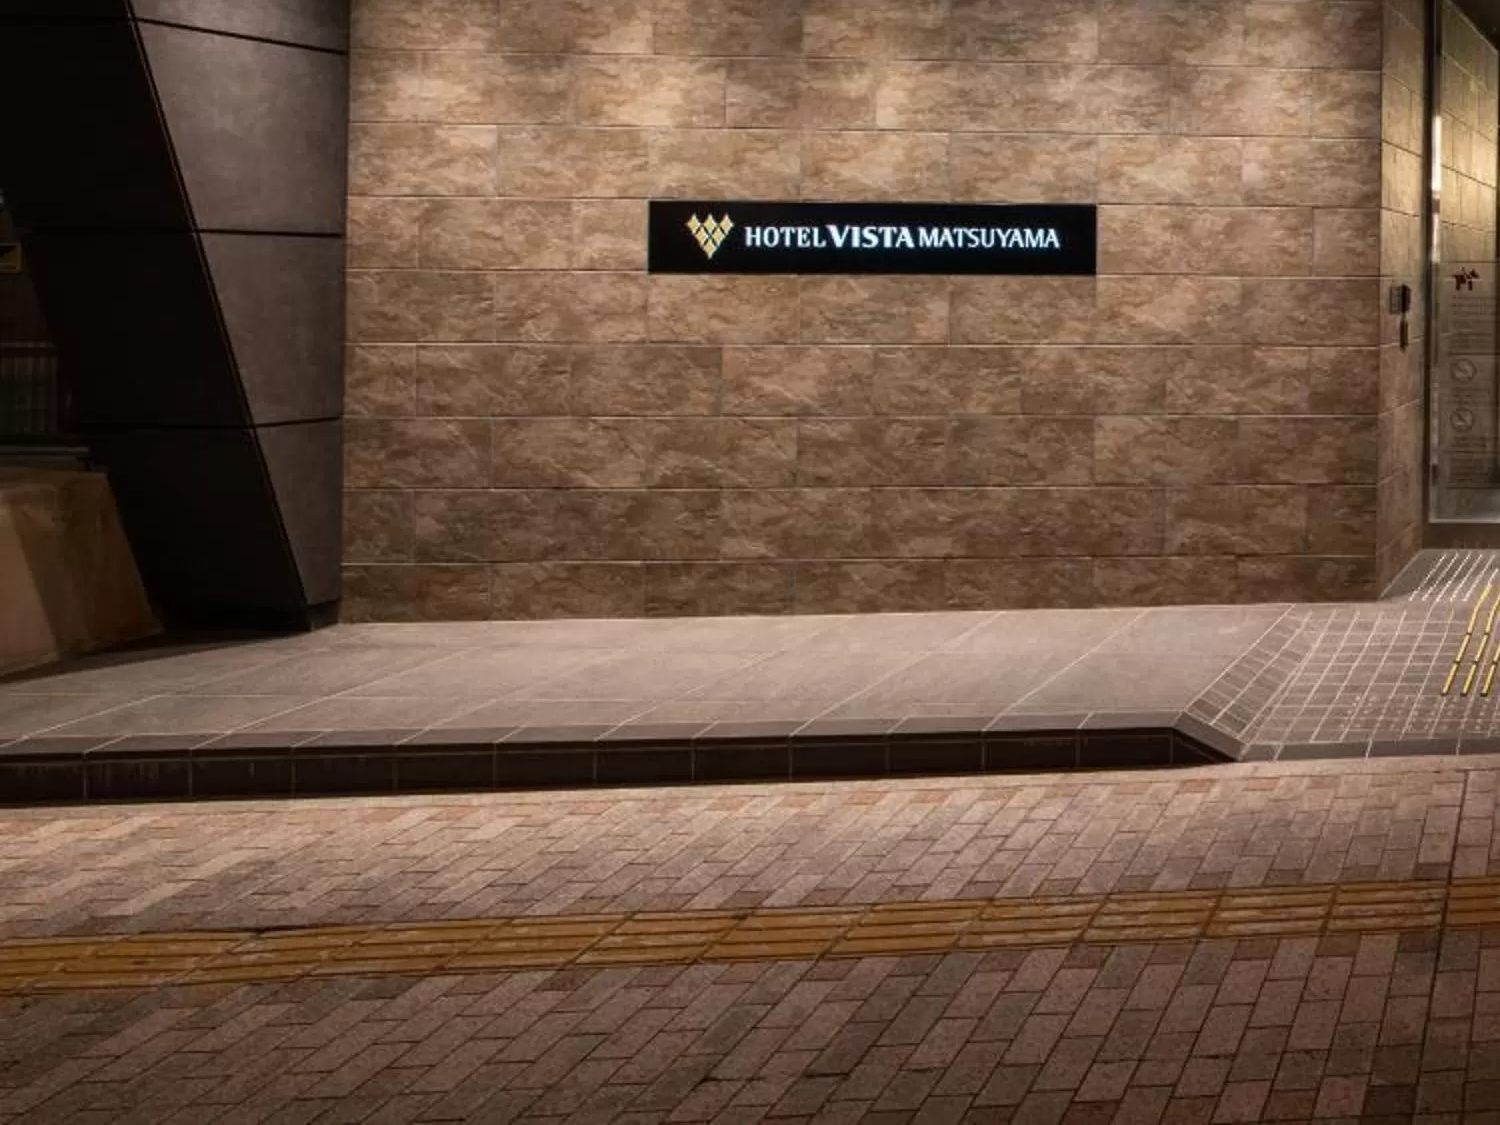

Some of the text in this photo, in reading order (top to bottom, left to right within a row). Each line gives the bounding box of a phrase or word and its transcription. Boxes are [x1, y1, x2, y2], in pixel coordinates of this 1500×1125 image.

[744, 224, 1061, 249] HOTEL VISTA MATSUYAMA
